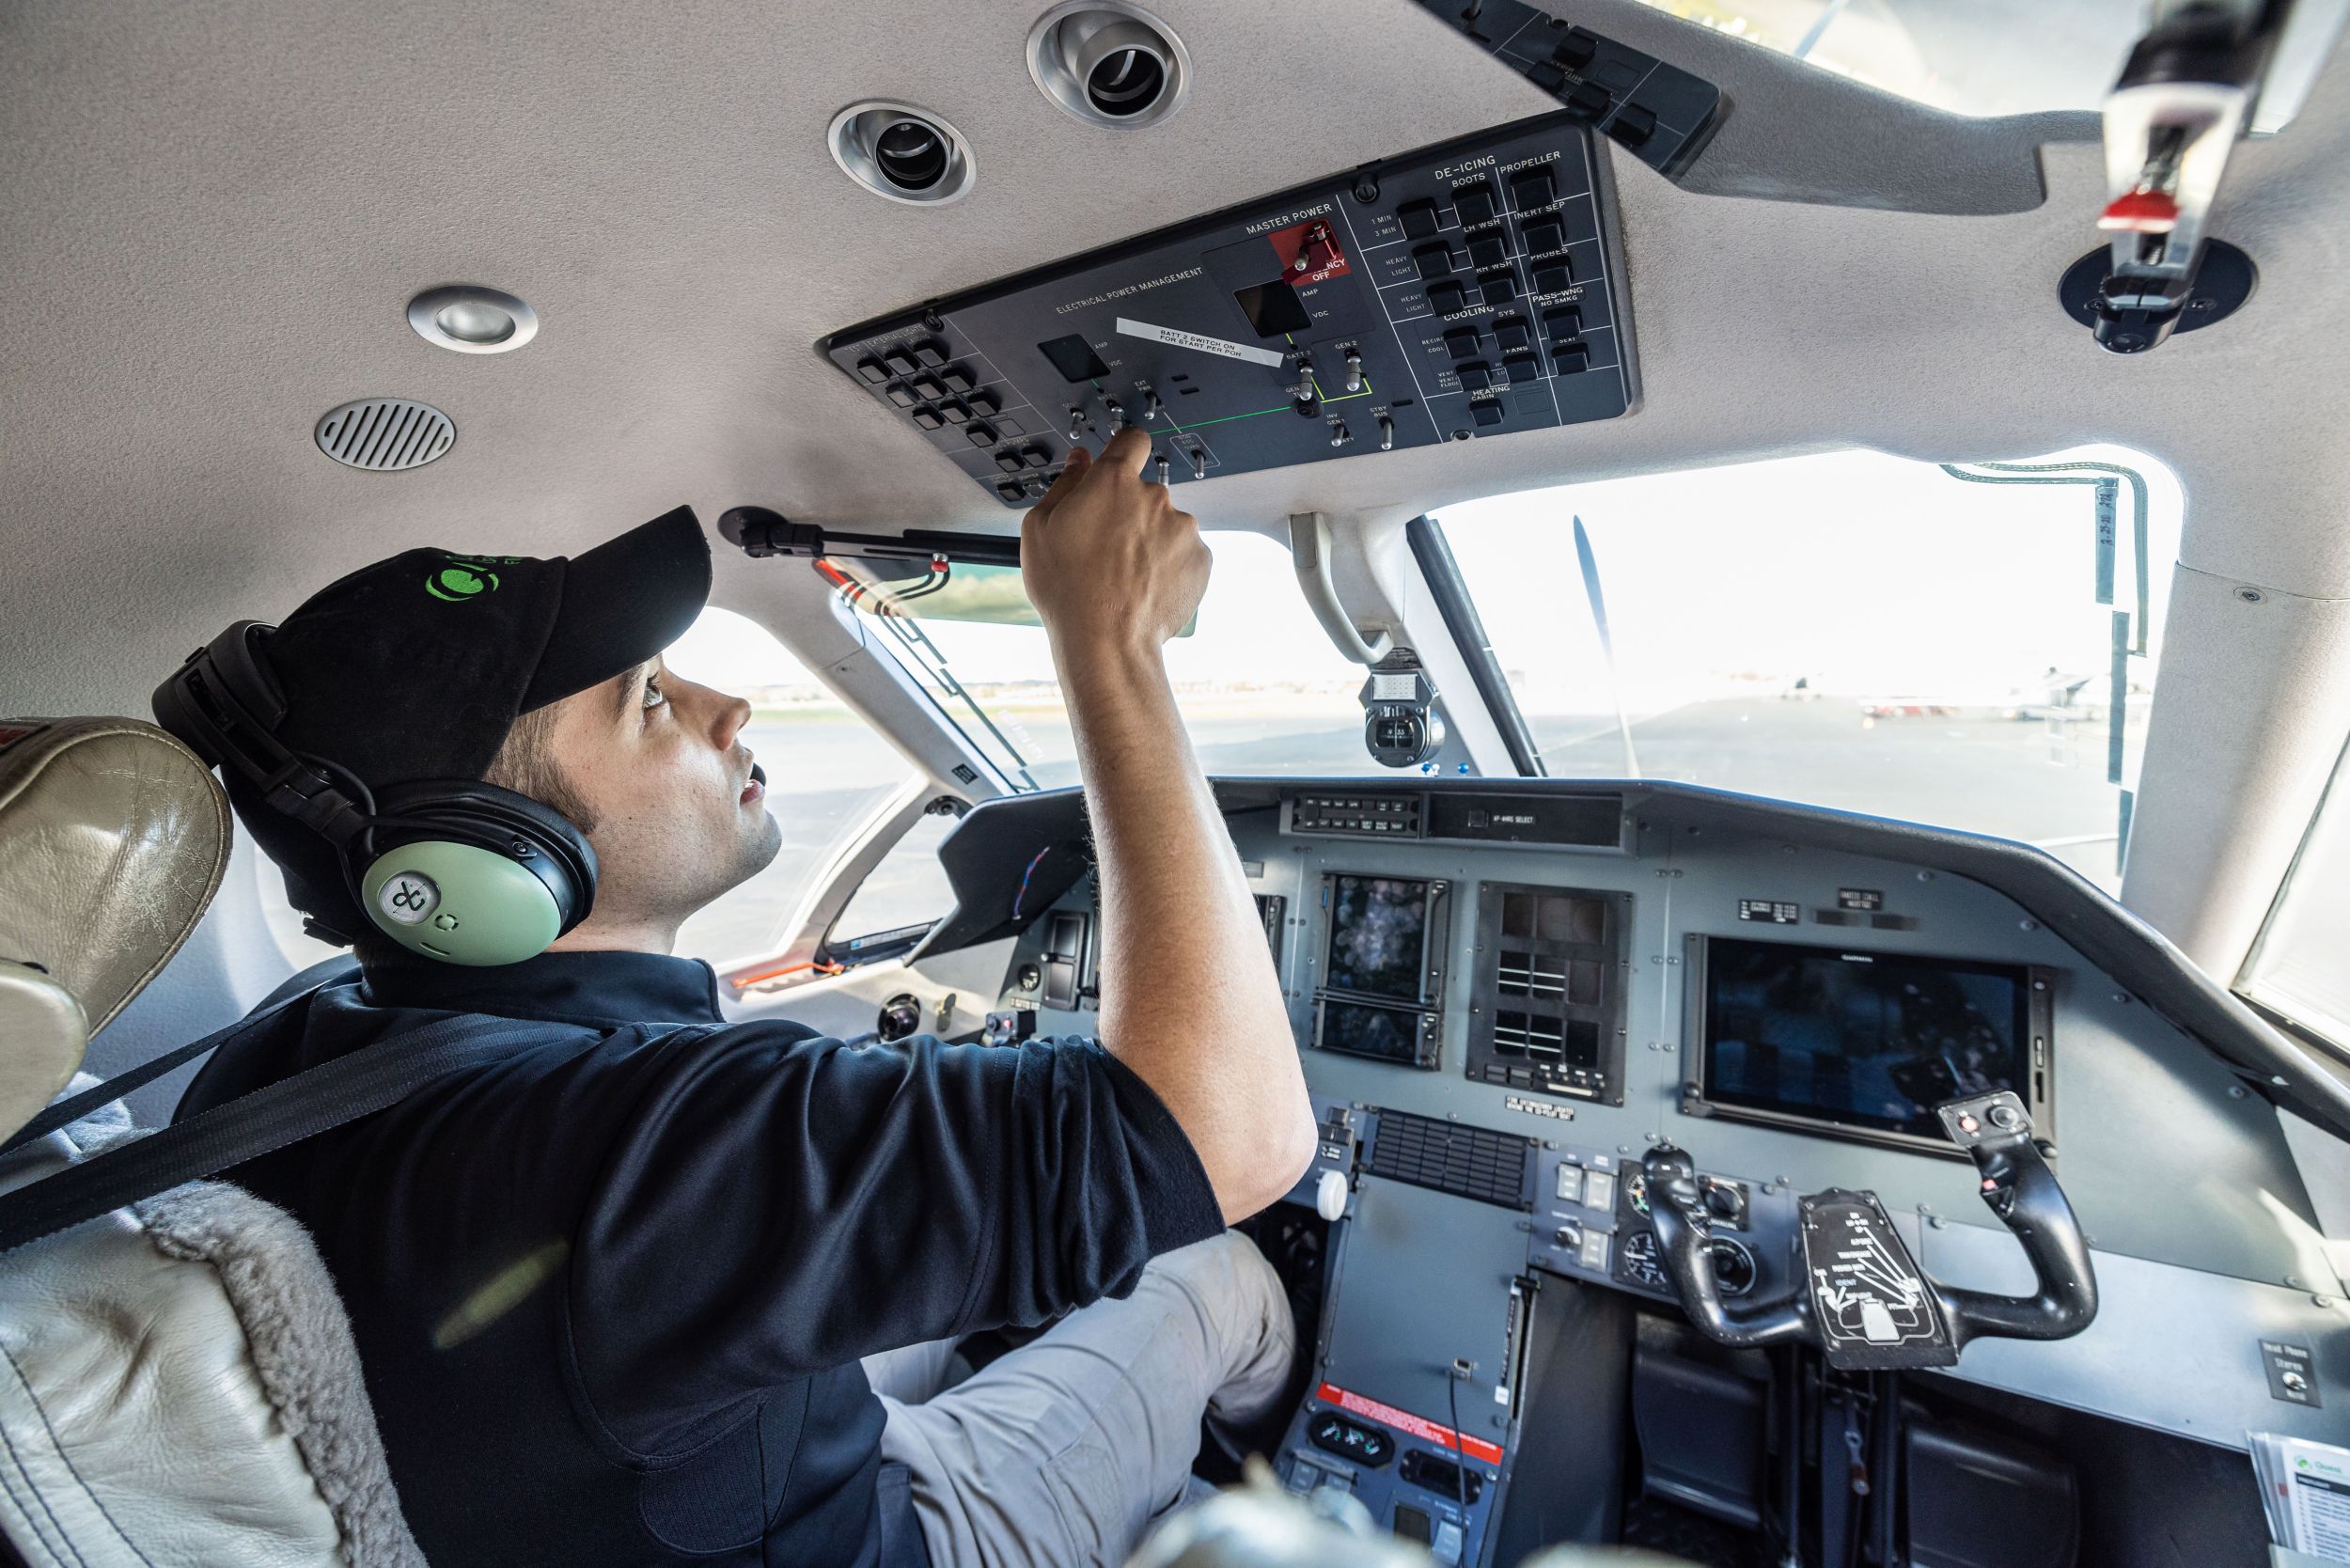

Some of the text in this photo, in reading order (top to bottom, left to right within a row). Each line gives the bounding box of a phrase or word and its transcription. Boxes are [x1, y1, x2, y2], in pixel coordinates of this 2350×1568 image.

[1499, 150, 1561, 174] PROPELLER
[1434, 155, 1496, 180] DE-ICING
[1451, 172, 1486, 188] BOOTS
[1513, 201, 1565, 220] INERT SEP
[1246, 203, 1333, 235] MASTER POWER
[1377, 214, 1392, 224] MIN
[1464, 218, 1501, 233] LH WSH
[1381, 227, 1397, 235] MIN
[1386, 256, 1407, 266] HEAVY
[1312, 271, 1330, 281] OFF
[1391, 266, 1412, 276] LIGHT
[1056, 266, 1203, 315] ELECTRICAL POWER MANAGEMENT
[1302, 288, 1319, 298] AMP
[1532, 286, 1583, 303] PASS-WNG
[1401, 293, 1422, 303] HEAVY
[1555, 295, 1578, 305] SMKG
[1406, 303, 1426, 313] LIGHT
[1497, 308, 1515, 318] SYS
[1443, 306, 1495, 321] COOLING
[1160, 330, 1181, 338] BATT
[1190, 337, 1221, 347] SWITCH
[1179, 338, 1204, 349] START
[1286, 352, 1305, 360] BATT
[1472, 385, 1511, 396] HEATING
[1471, 393, 1495, 401] CABIN
